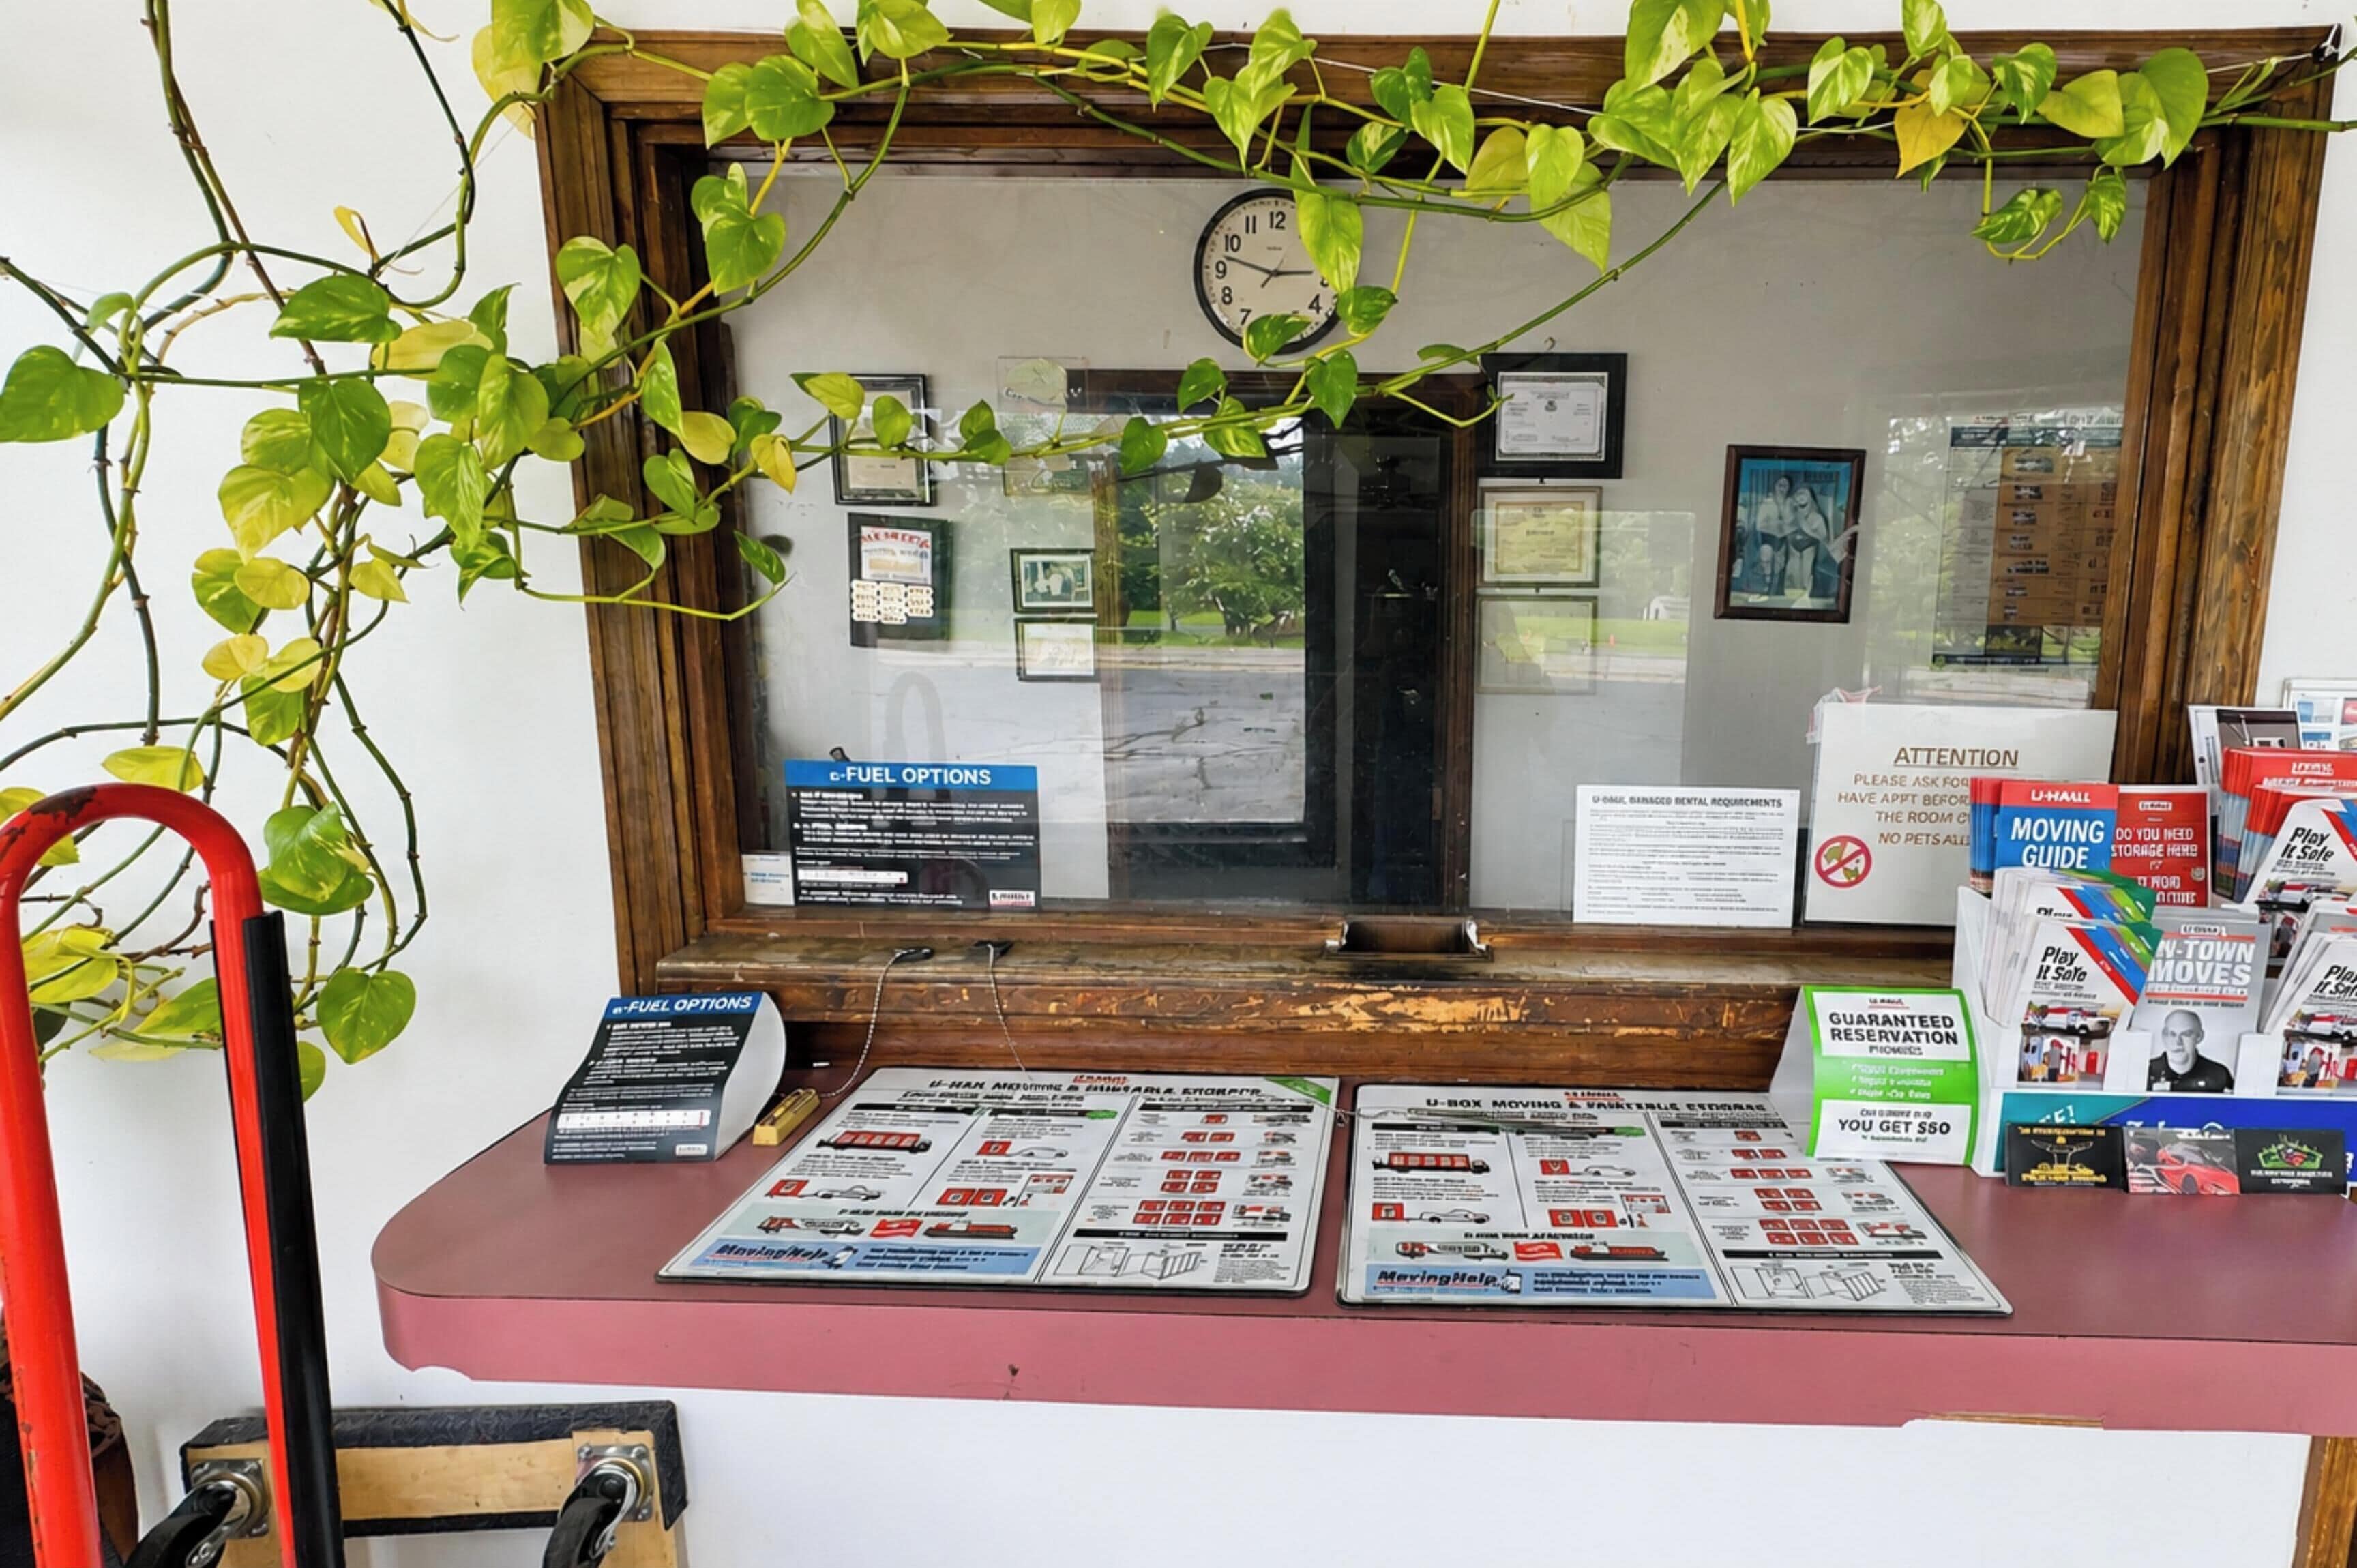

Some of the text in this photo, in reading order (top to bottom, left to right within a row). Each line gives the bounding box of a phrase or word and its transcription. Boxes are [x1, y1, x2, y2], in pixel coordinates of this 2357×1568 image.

[1245, 215, 1256, 234] 11
[1269, 211, 1286, 230] 12
[1224, 234, 1241, 253] 10
[1215, 260, 1227, 280] 9
[1221, 286, 1233, 306] 8
[1308, 293, 1322, 314] 4
[1240, 308, 1252, 326] 7
[1893, 747, 2019, 767] ATTENTION
[902, 767, 992, 785] OPTIONS
[1854, 773, 1907, 786] PLEASE
[1912, 775, 1939, 787] ASK
[1837, 792, 1971, 806] HAVE APPT BEFOR
[1876, 811, 1903, 823] THE
[1907, 812, 1953, 824] ROOM
[1878, 832, 1901, 844] NO
[1904, 833, 1940, 846] PETS
[2011, 817, 2105, 844] MOVING
[2116, 827, 2133, 840] DO
[2136, 827, 2160, 840] YOU
[2289, 827, 2331, 846] Play
[2021, 844, 2090, 869] GUIDE
[2041, 946, 2079, 966] Play
[2155, 938, 2256, 964] N-TOWN
[2148, 960, 2252, 986] MOVES
[674, 996, 753, 1012] OPTIONS
[1828, 1012, 1955, 1029] GUARANTEED
[1830, 1028, 1959, 1046] RESERVATION
[1492, 1099, 1562, 1110] MOVING
[1839, 1119, 1873, 1132] YOU
[1879, 1120, 1913, 1134] GET
